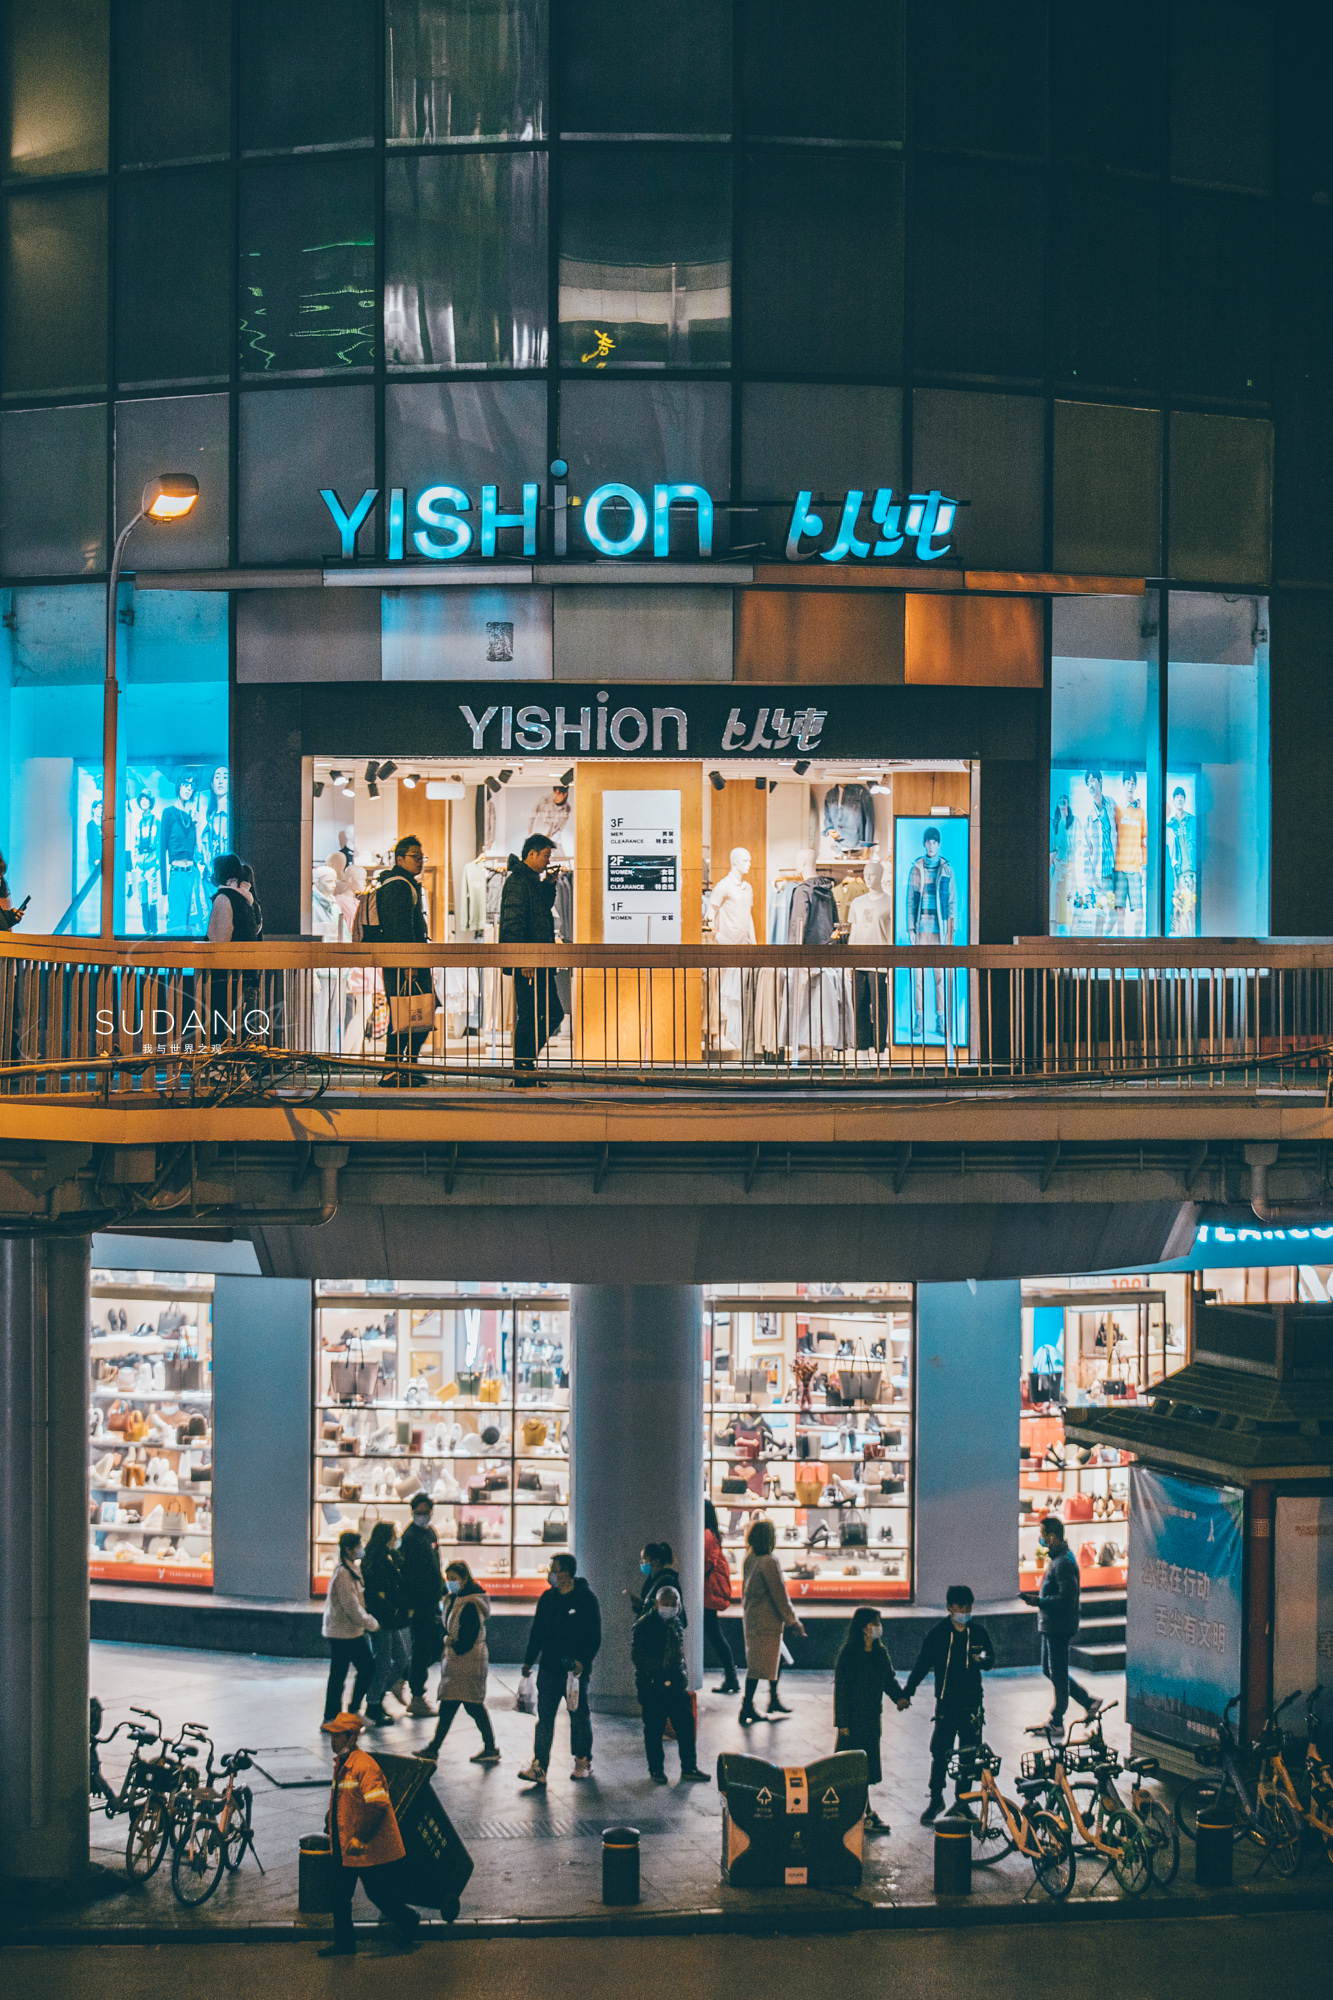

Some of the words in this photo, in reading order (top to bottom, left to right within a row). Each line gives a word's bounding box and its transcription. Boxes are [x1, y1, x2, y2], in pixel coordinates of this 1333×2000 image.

[610, 817, 624, 828] 3F
[609, 856, 624, 866] 2F
[611, 902, 624, 911] 1F
[1141, 1555, 1210, 1601] 公筷在行动
[1154, 1604, 1226, 1653] 舌尖有文明
